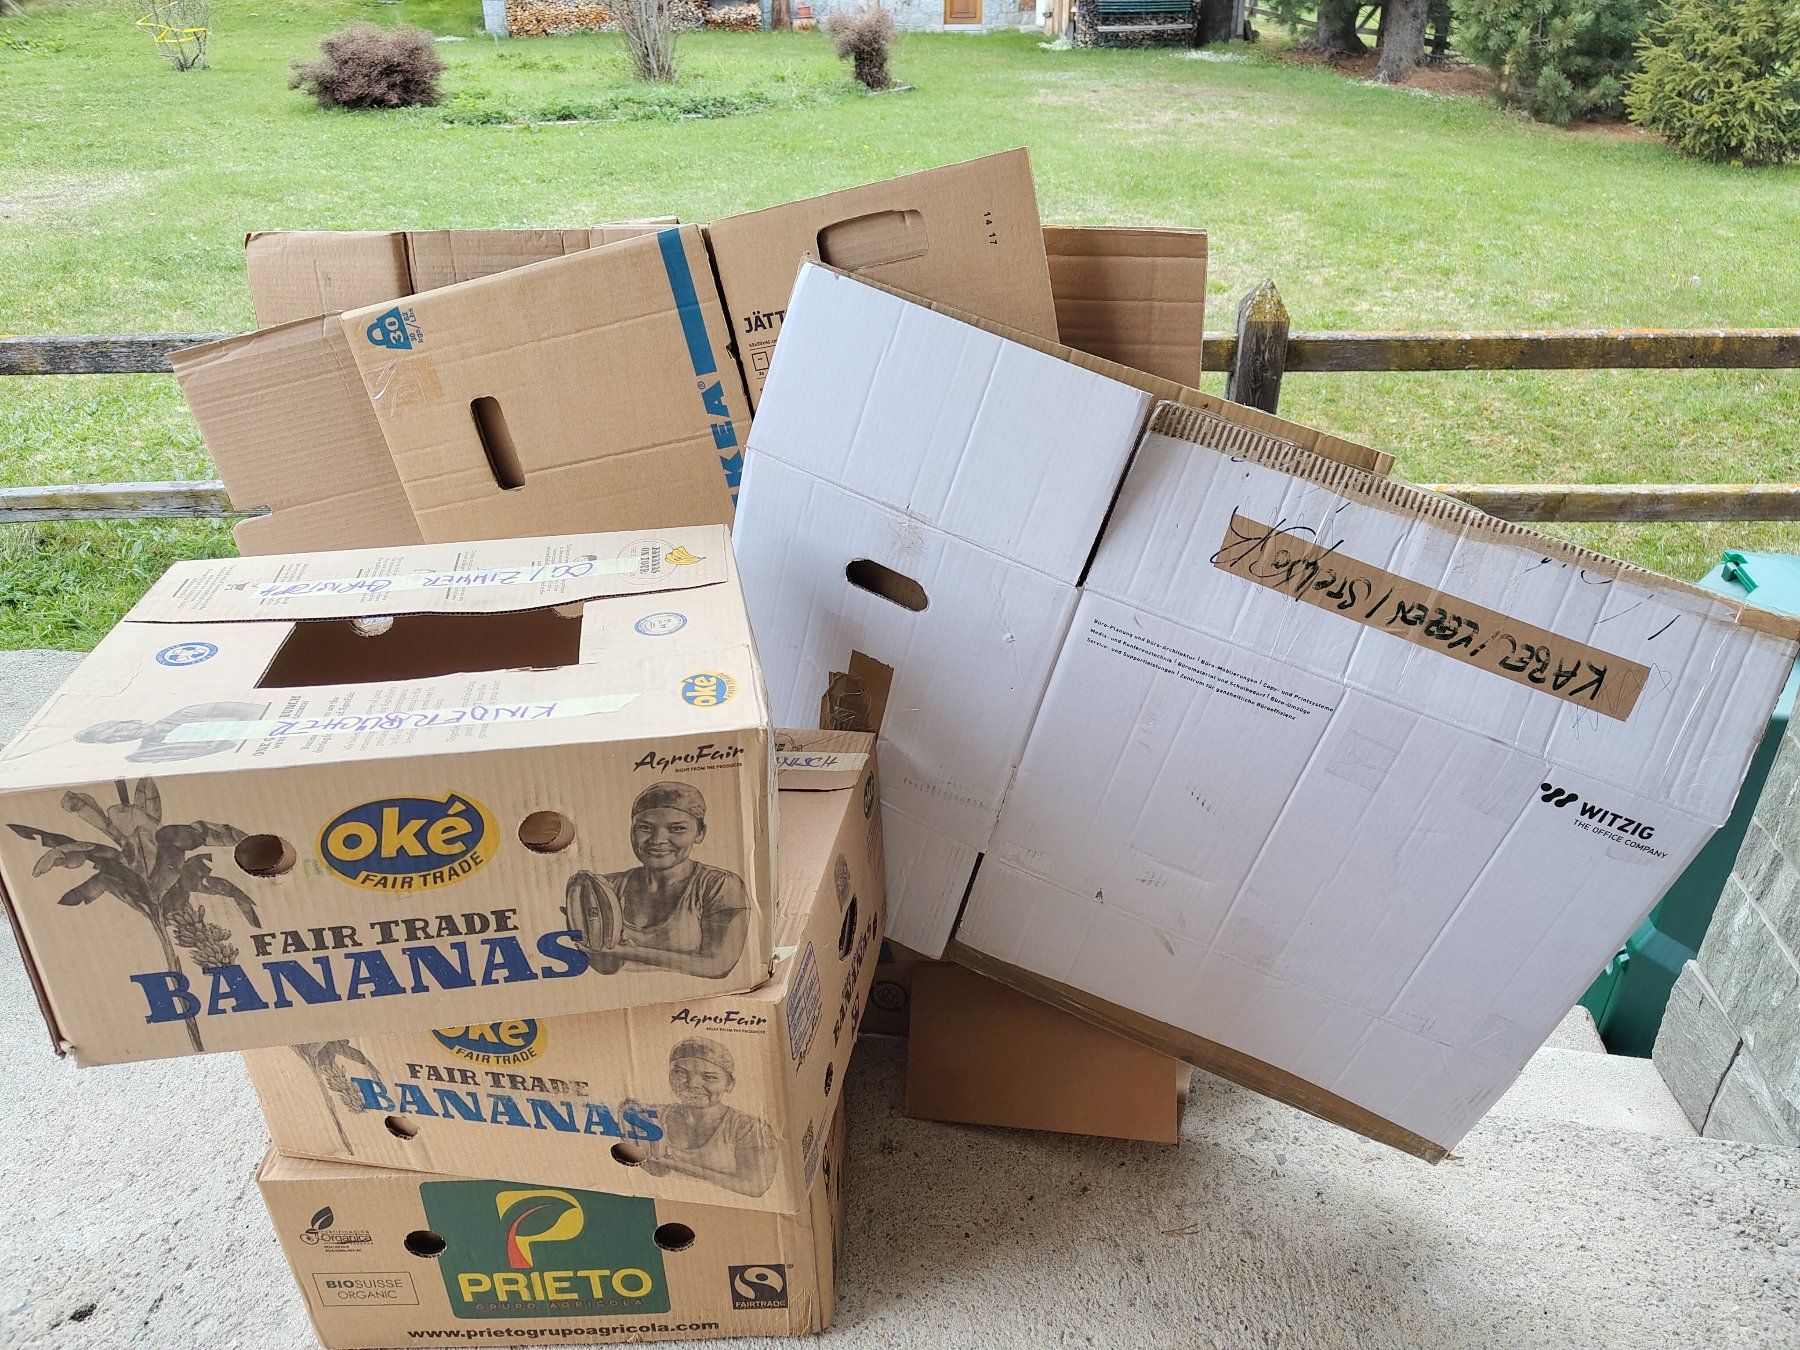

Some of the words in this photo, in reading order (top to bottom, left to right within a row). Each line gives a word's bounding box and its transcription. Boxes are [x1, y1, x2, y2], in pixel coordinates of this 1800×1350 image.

[385, 317, 404, 345] 30
[701, 380, 744, 509] KEA
[1123, 652, 1175, 675] Supportleistungen
[1179, 674, 1205, 686] Zentrum
[1294, 694, 1334, 712] Printsysteme
[633, 744, 744, 774] AgroFair
[327, 801, 473, 861] oké
[1580, 802, 1655, 840] WITZIG
[1573, 819, 1592, 831] THE
[1592, 826, 1624, 843] OFFICE
[1624, 839, 1668, 859] COMPANY
[360, 873, 414, 889] FAIR
[418, 851, 484, 887] TRADE
[250, 926, 358, 957] FAIR
[370, 908, 519, 945] TRADE
[130, 929, 589, 1025] BANANAS
[670, 1008, 766, 1029] AgroFair
[456, 1048, 490, 1064] FAIR
[493, 1047, 538, 1065] TRADE
[407, 1062, 481, 1086] FAIR
[485, 1072, 589, 1097] TRADE
[350, 1076, 664, 1142] BANANAS
[337, 1290, 398, 1300] ORGANIC
[457, 1268, 653, 1302] PRIETO
[475, 1302, 536, 1311] GRUPO
[549, 1299, 644, 1310] AGRICOLA
[736, 1301, 786, 1309] FAIRTRADE
[407, 1321, 720, 1339] www.prietogrupoagricola.com
